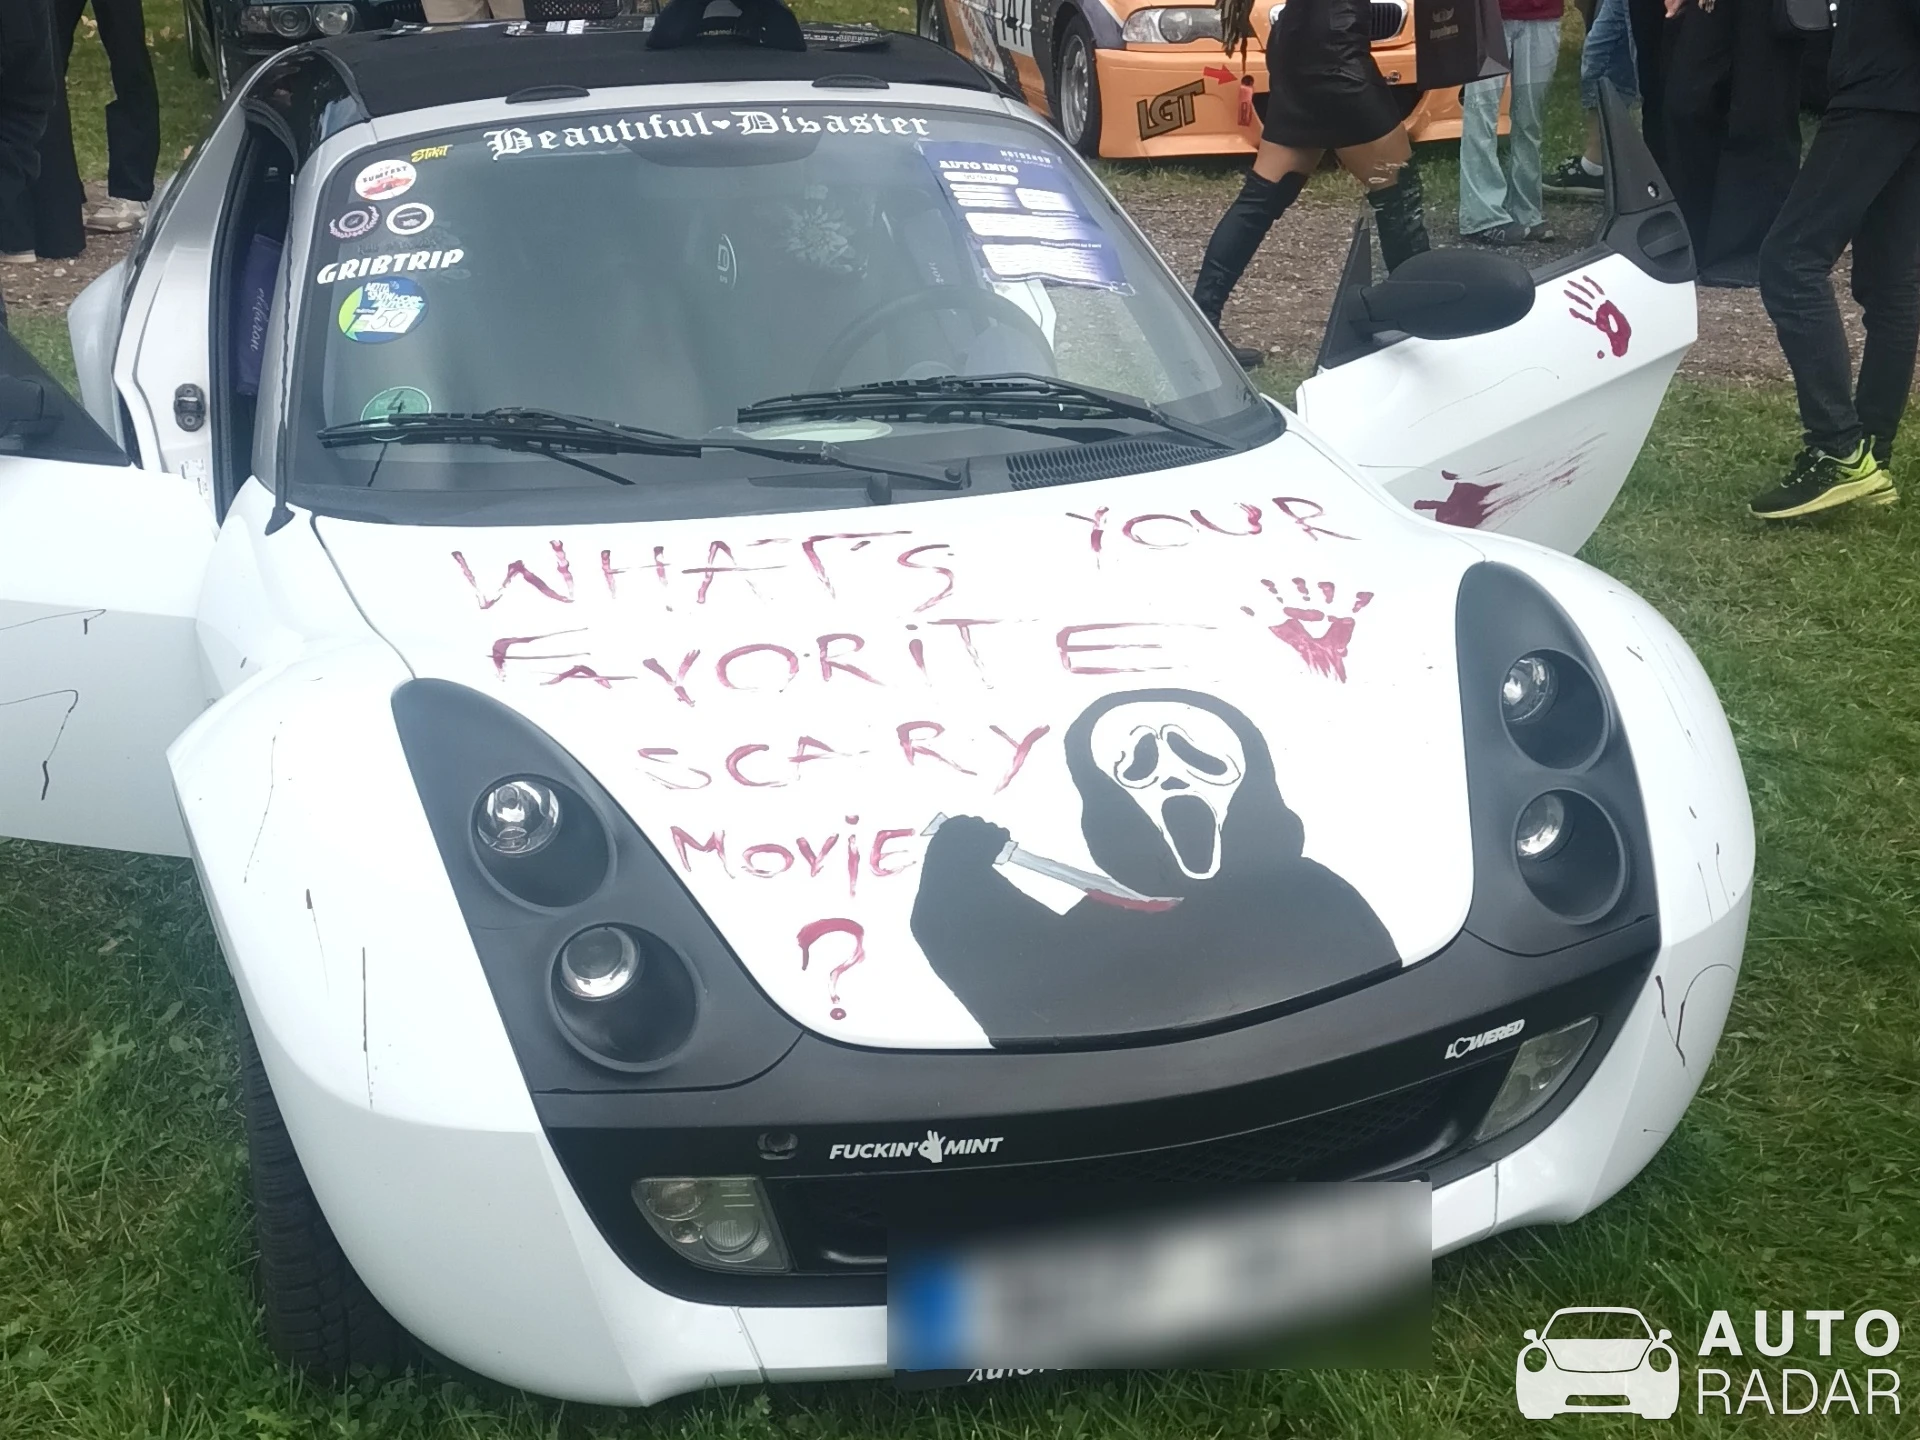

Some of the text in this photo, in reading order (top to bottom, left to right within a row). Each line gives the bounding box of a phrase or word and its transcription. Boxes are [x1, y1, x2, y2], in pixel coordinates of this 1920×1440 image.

[483, 108, 930, 161] Beautiful Disaster
[1137, 78, 1206, 141] LGT
[939, 160, 982, 170] AUTO
[983, 162, 1019, 174] INFO
[316, 248, 465, 284] GRIBTRIP
[451, 496, 1362, 613] WHAT'S YOUR
[636, 720, 1050, 795] SCARY
[796, 917, 865, 1020] ?
[942, 1136, 1004, 1156] MINT
